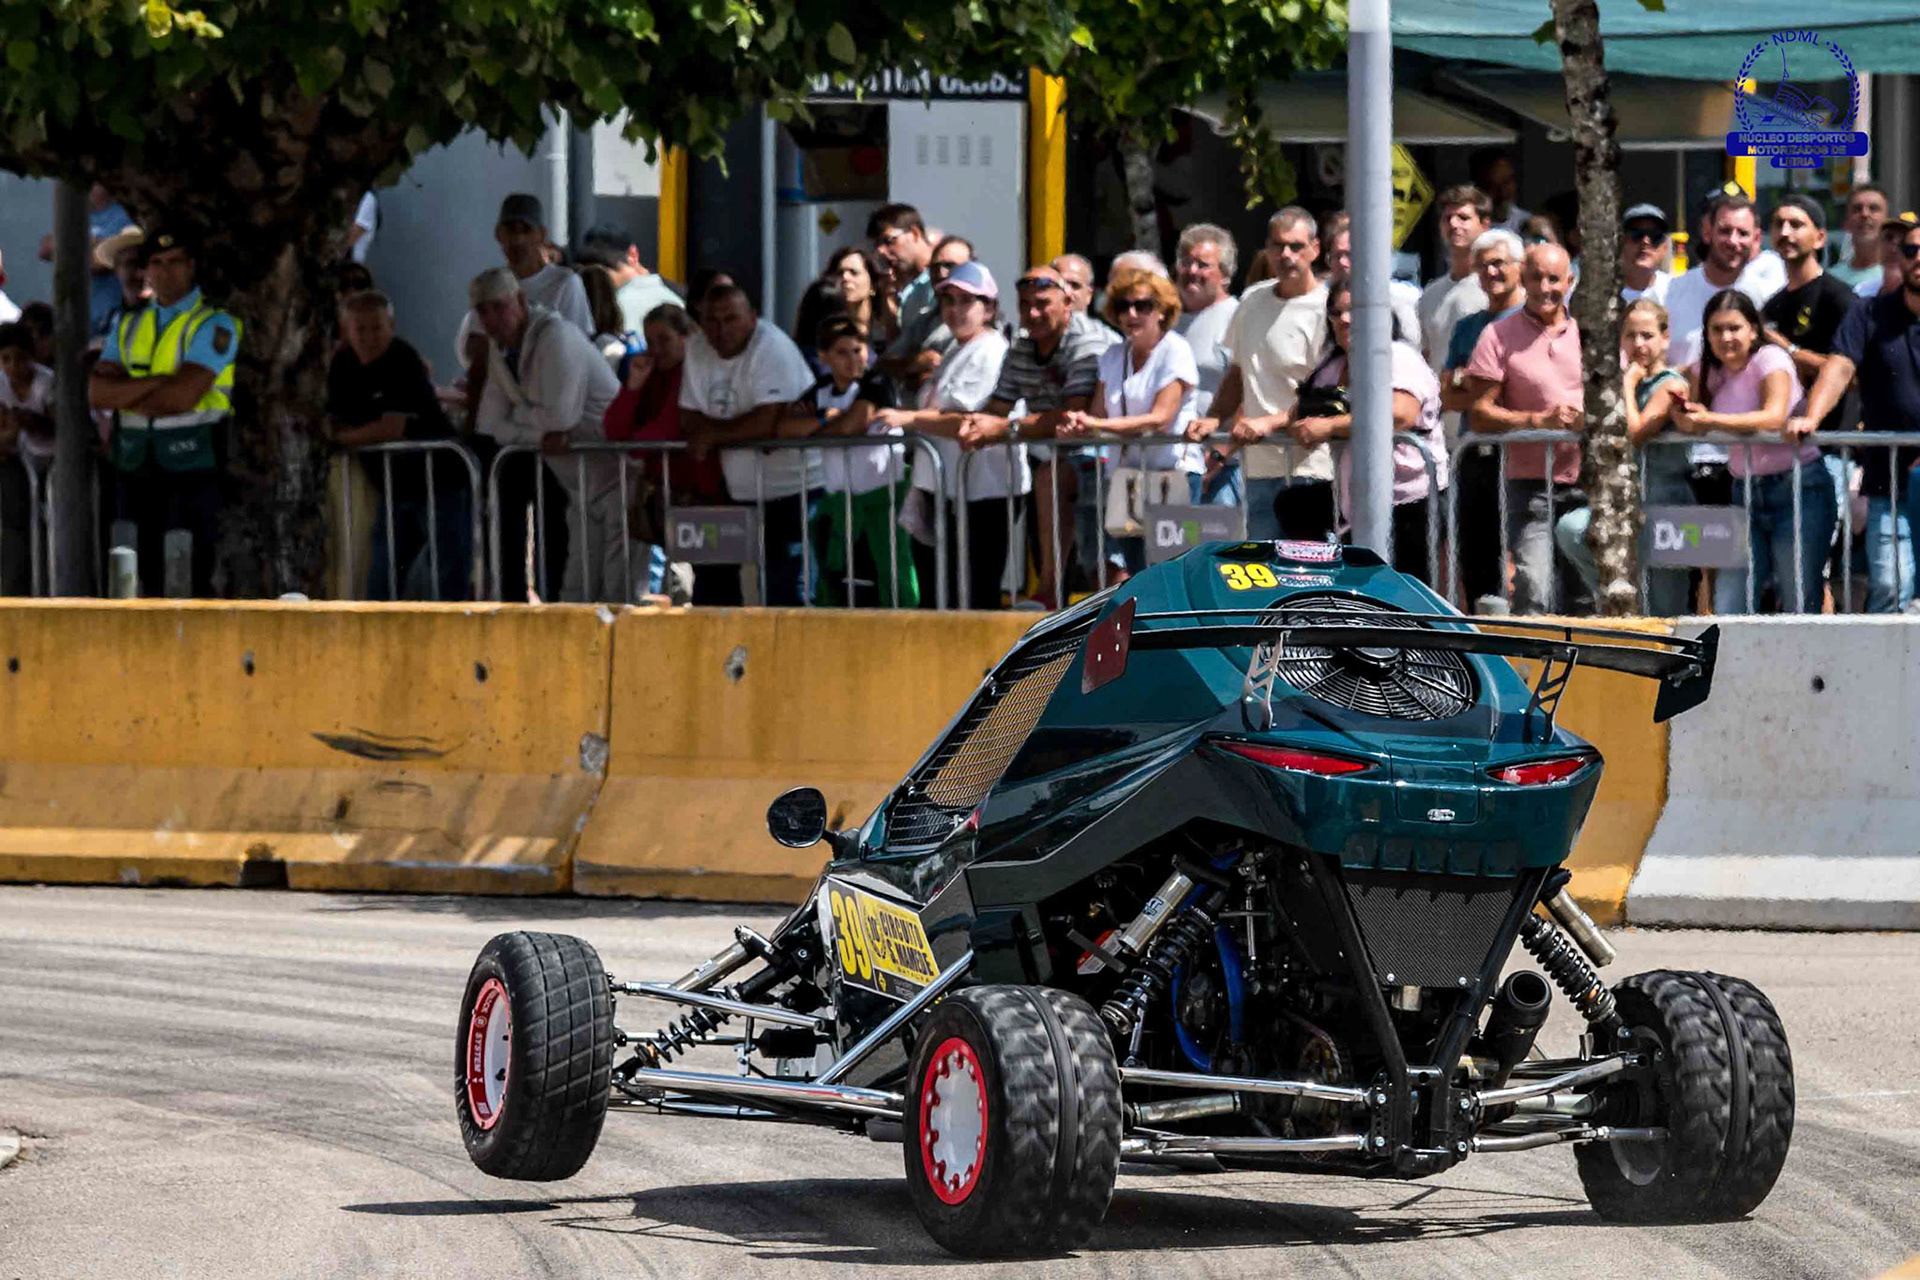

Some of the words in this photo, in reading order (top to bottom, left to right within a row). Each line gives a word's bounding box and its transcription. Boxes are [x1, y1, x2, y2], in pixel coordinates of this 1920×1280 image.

[1220, 563, 1279, 590] 39
[830, 890, 872, 980] 39
[879, 910, 925, 950] CIRCUITO
[473, 1032, 484, 1073] SYSTEM
